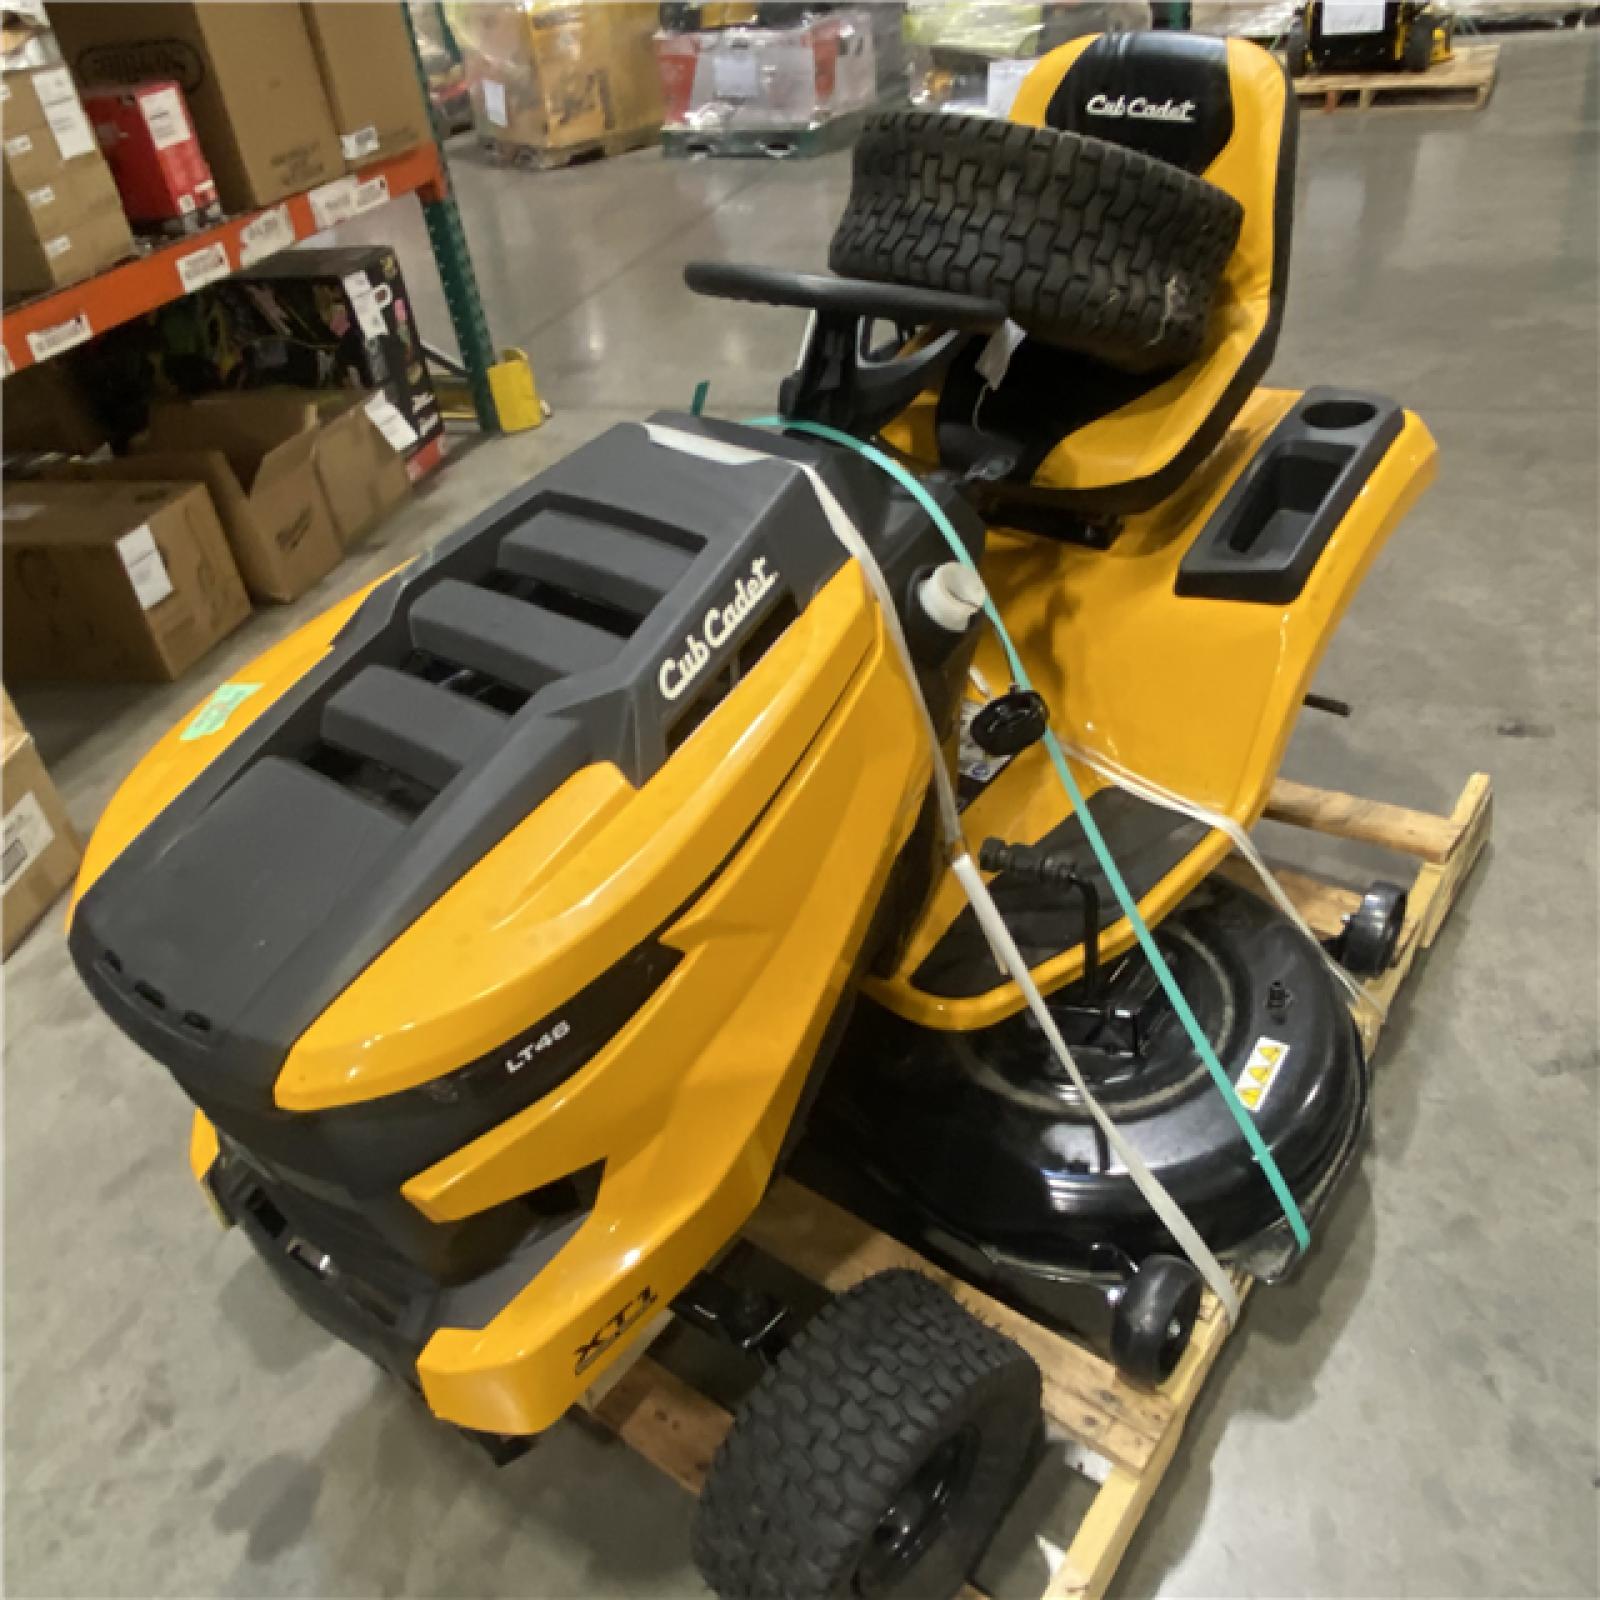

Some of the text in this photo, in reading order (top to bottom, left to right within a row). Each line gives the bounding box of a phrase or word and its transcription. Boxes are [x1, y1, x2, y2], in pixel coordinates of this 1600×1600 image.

[1086, 95, 1195, 121] Cub Cadet
[659, 556, 780, 700] Cub Cadet
[505, 1020, 570, 1073] LT46
[573, 1285, 658, 1361] XT1
